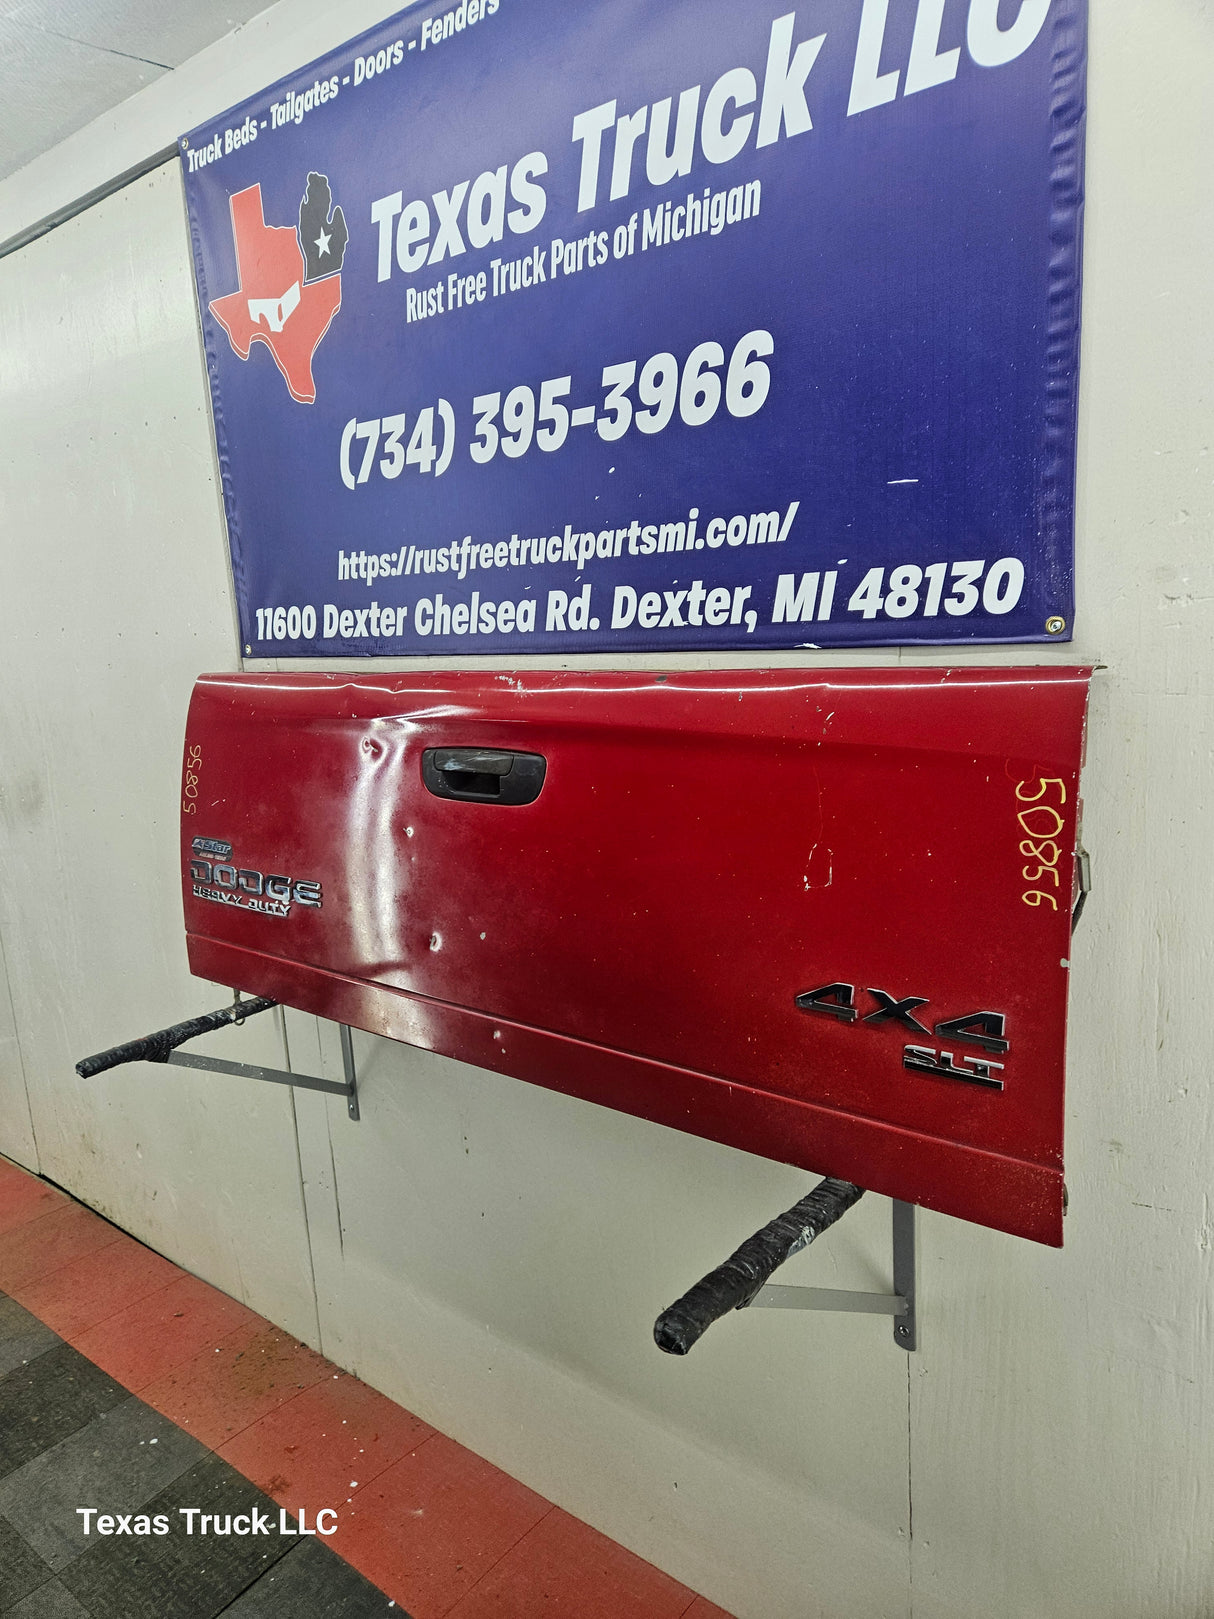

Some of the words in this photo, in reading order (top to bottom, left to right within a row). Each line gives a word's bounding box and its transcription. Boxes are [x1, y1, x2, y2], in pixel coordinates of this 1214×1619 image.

[187, 136, 223, 173] Truck
[224, 115, 258, 155] Beds
[270, 75, 340, 131] Tailgates
[354, 38, 404, 87] Doors
[420, 0, 500, 51] Fenders
[371, 151, 548, 283] Texas
[572, 11, 827, 213] Truck
[406, 280, 445, 323] Rust
[448, 271, 487, 311] Free
[489, 246, 546, 297] Truck
[550, 229, 609, 279] Parts
[613, 212, 639, 259] of
[642, 179, 762, 251] Michigan
[339, 398, 456, 490] (734)
[470, 330, 775, 464] 395-3966
[338, 501, 801, 586] https://rustfreetruckpartsmi.com/
[256, 604, 317, 641] 11600
[322, 602, 408, 639] Dexter
[415, 591, 537, 636] Chelsea
[546, 583, 600, 632] Rd.
[611, 580, 758, 633] Dexter,
[772, 571, 838, 622] MI
[847, 557, 1025, 619] 48130
[183, 744, 203, 815] 50856
[190, 859, 323, 909] DODGE
[1015, 777, 1066, 911] 50856
[193, 884, 242, 905] HEAVY
[248, 897, 292, 915] DUTY
[904, 1045, 1005, 1080] SLT
